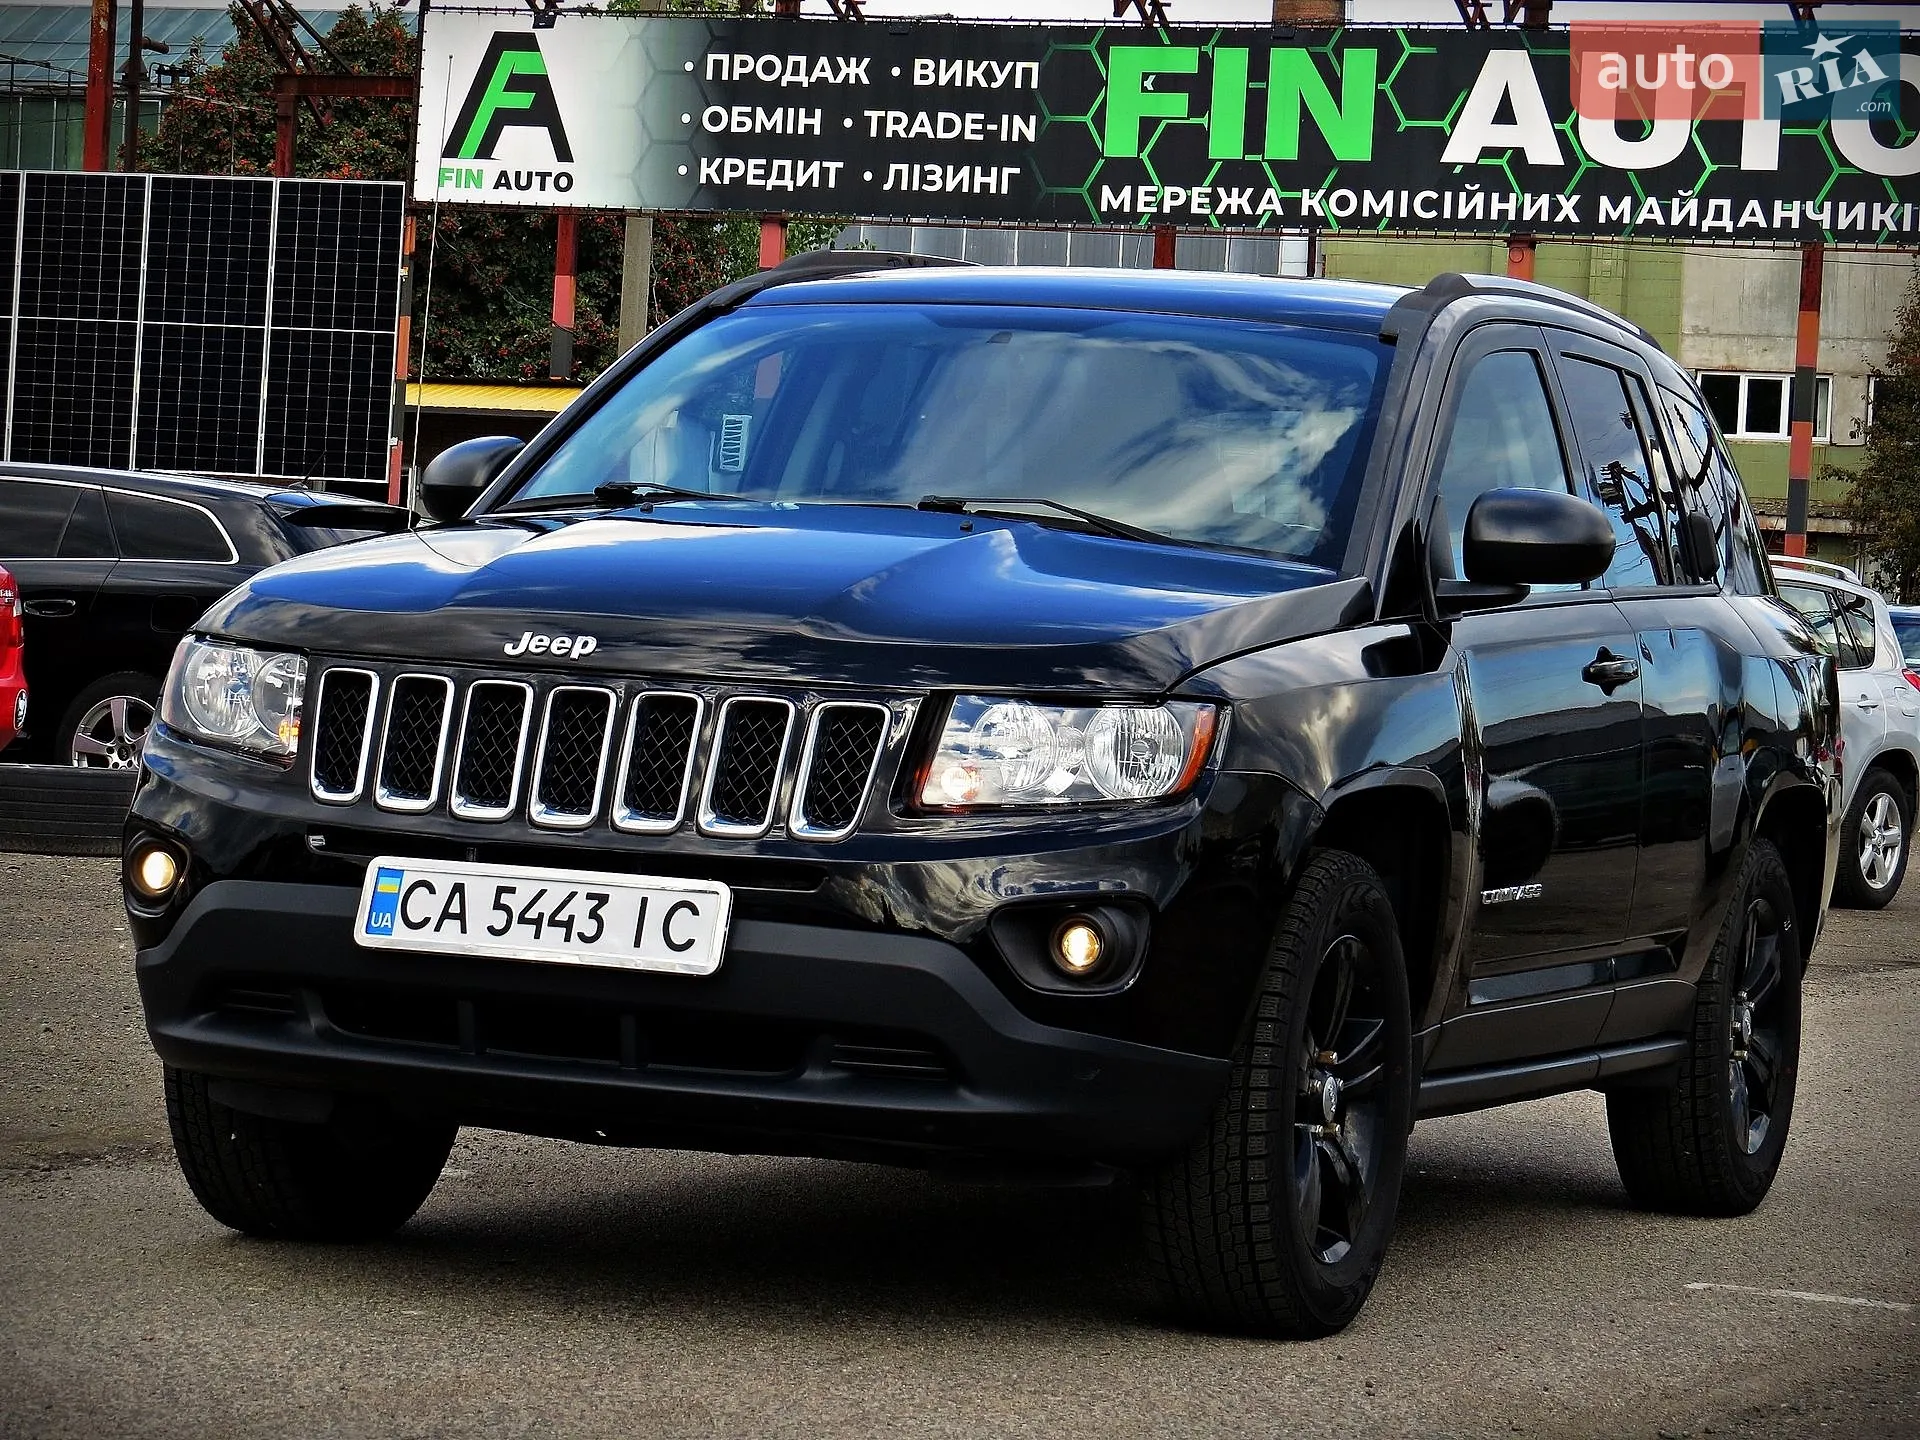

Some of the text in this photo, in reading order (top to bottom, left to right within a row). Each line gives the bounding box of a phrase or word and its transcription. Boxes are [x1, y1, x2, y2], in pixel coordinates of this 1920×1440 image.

[705, 54, 1040, 90] ПРОДАЖ ВИКУП
[1104, 46, 1374, 162] FIN
[702, 105, 1038, 143] ОБМІН TRADE-IN
[439, 167, 574, 192] FIN AUTO
[700, 157, 1020, 195] КРЕДИТ ЛІЗИНГ
[1100, 183, 1920, 233] МЕРЕЖА КОМІСІЙНИХ МАЙДАНЧИКІ
[503, 630, 598, 660] Jeep
[370, 911, 394, 929] UA
[399, 879, 701, 952] CA 5443 IC
